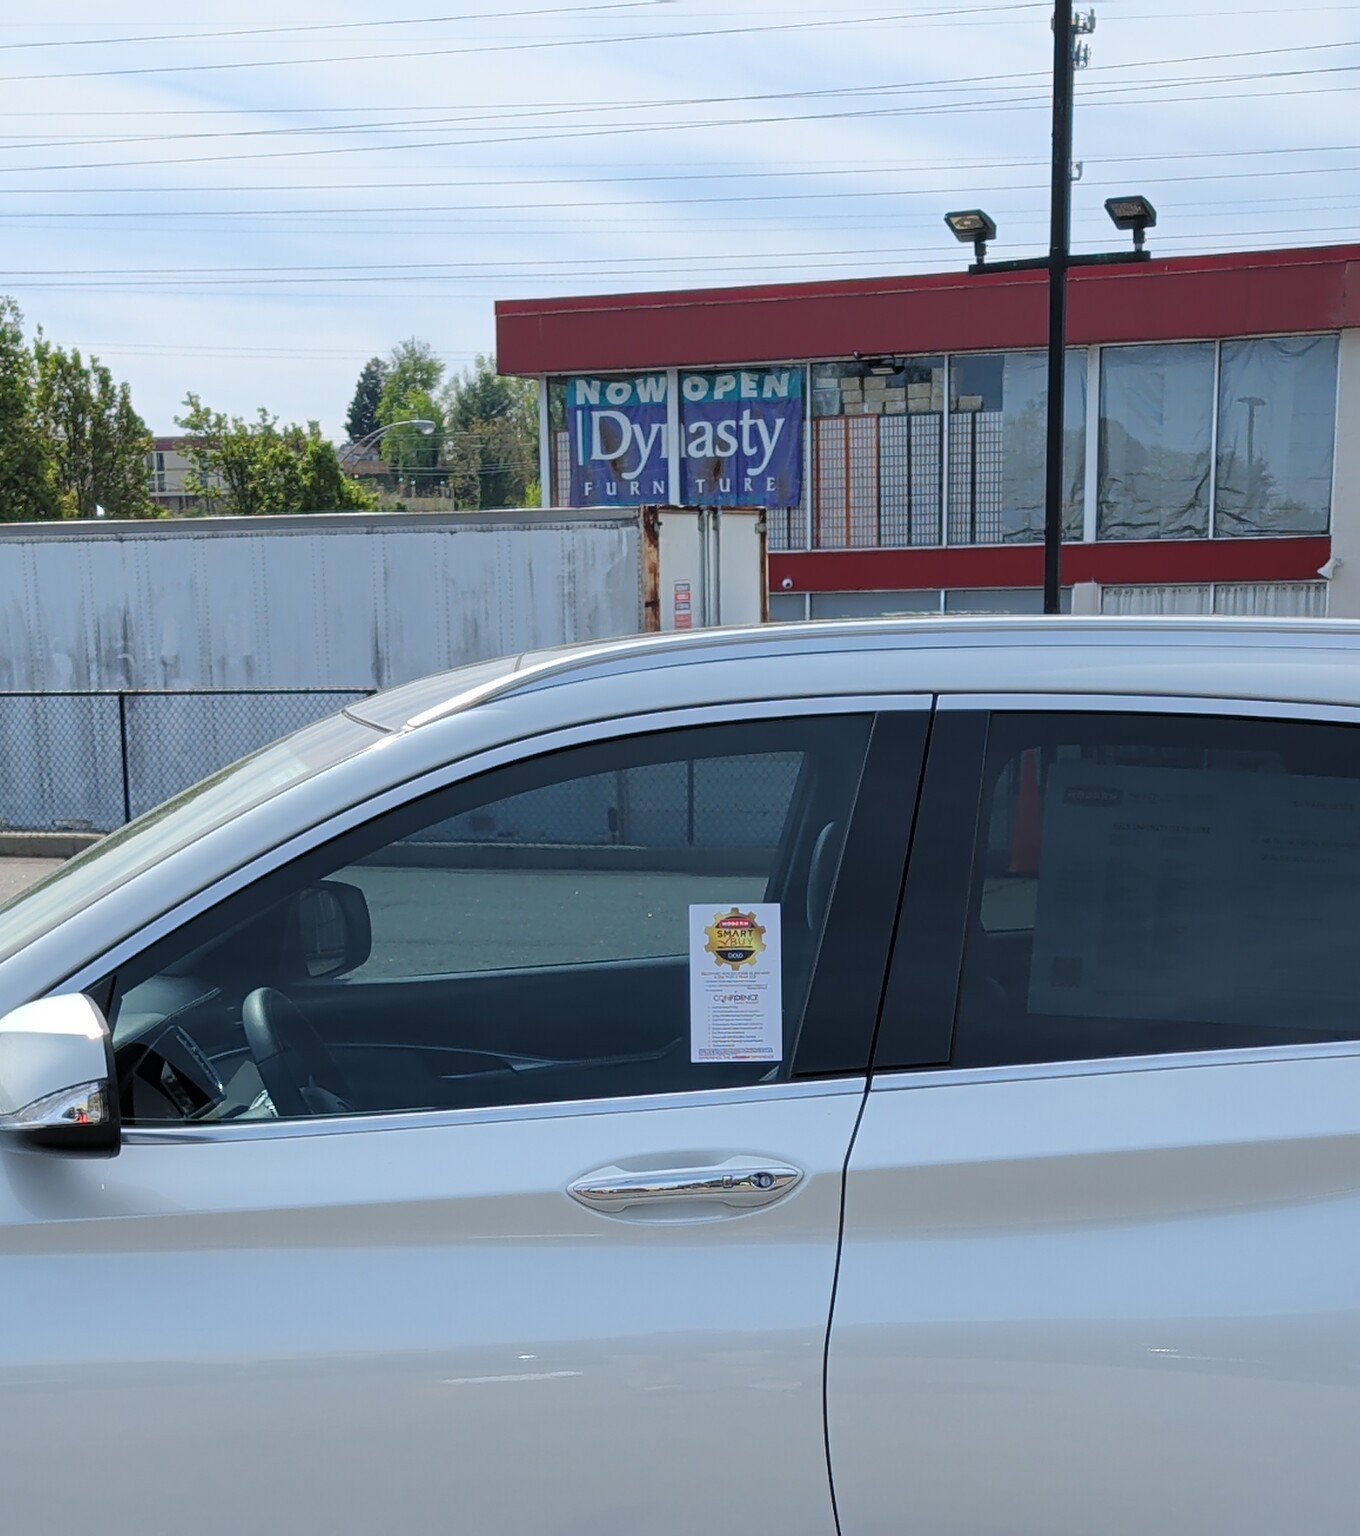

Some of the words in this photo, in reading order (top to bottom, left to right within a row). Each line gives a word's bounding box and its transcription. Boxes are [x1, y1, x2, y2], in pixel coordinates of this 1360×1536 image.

[575, 376, 669, 405] NOW
[682, 373, 790, 401] OPEN
[584, 477, 778, 497] FURNTURE
[717, 929, 754, 938] SMART
[730, 937, 754, 946] BUY
